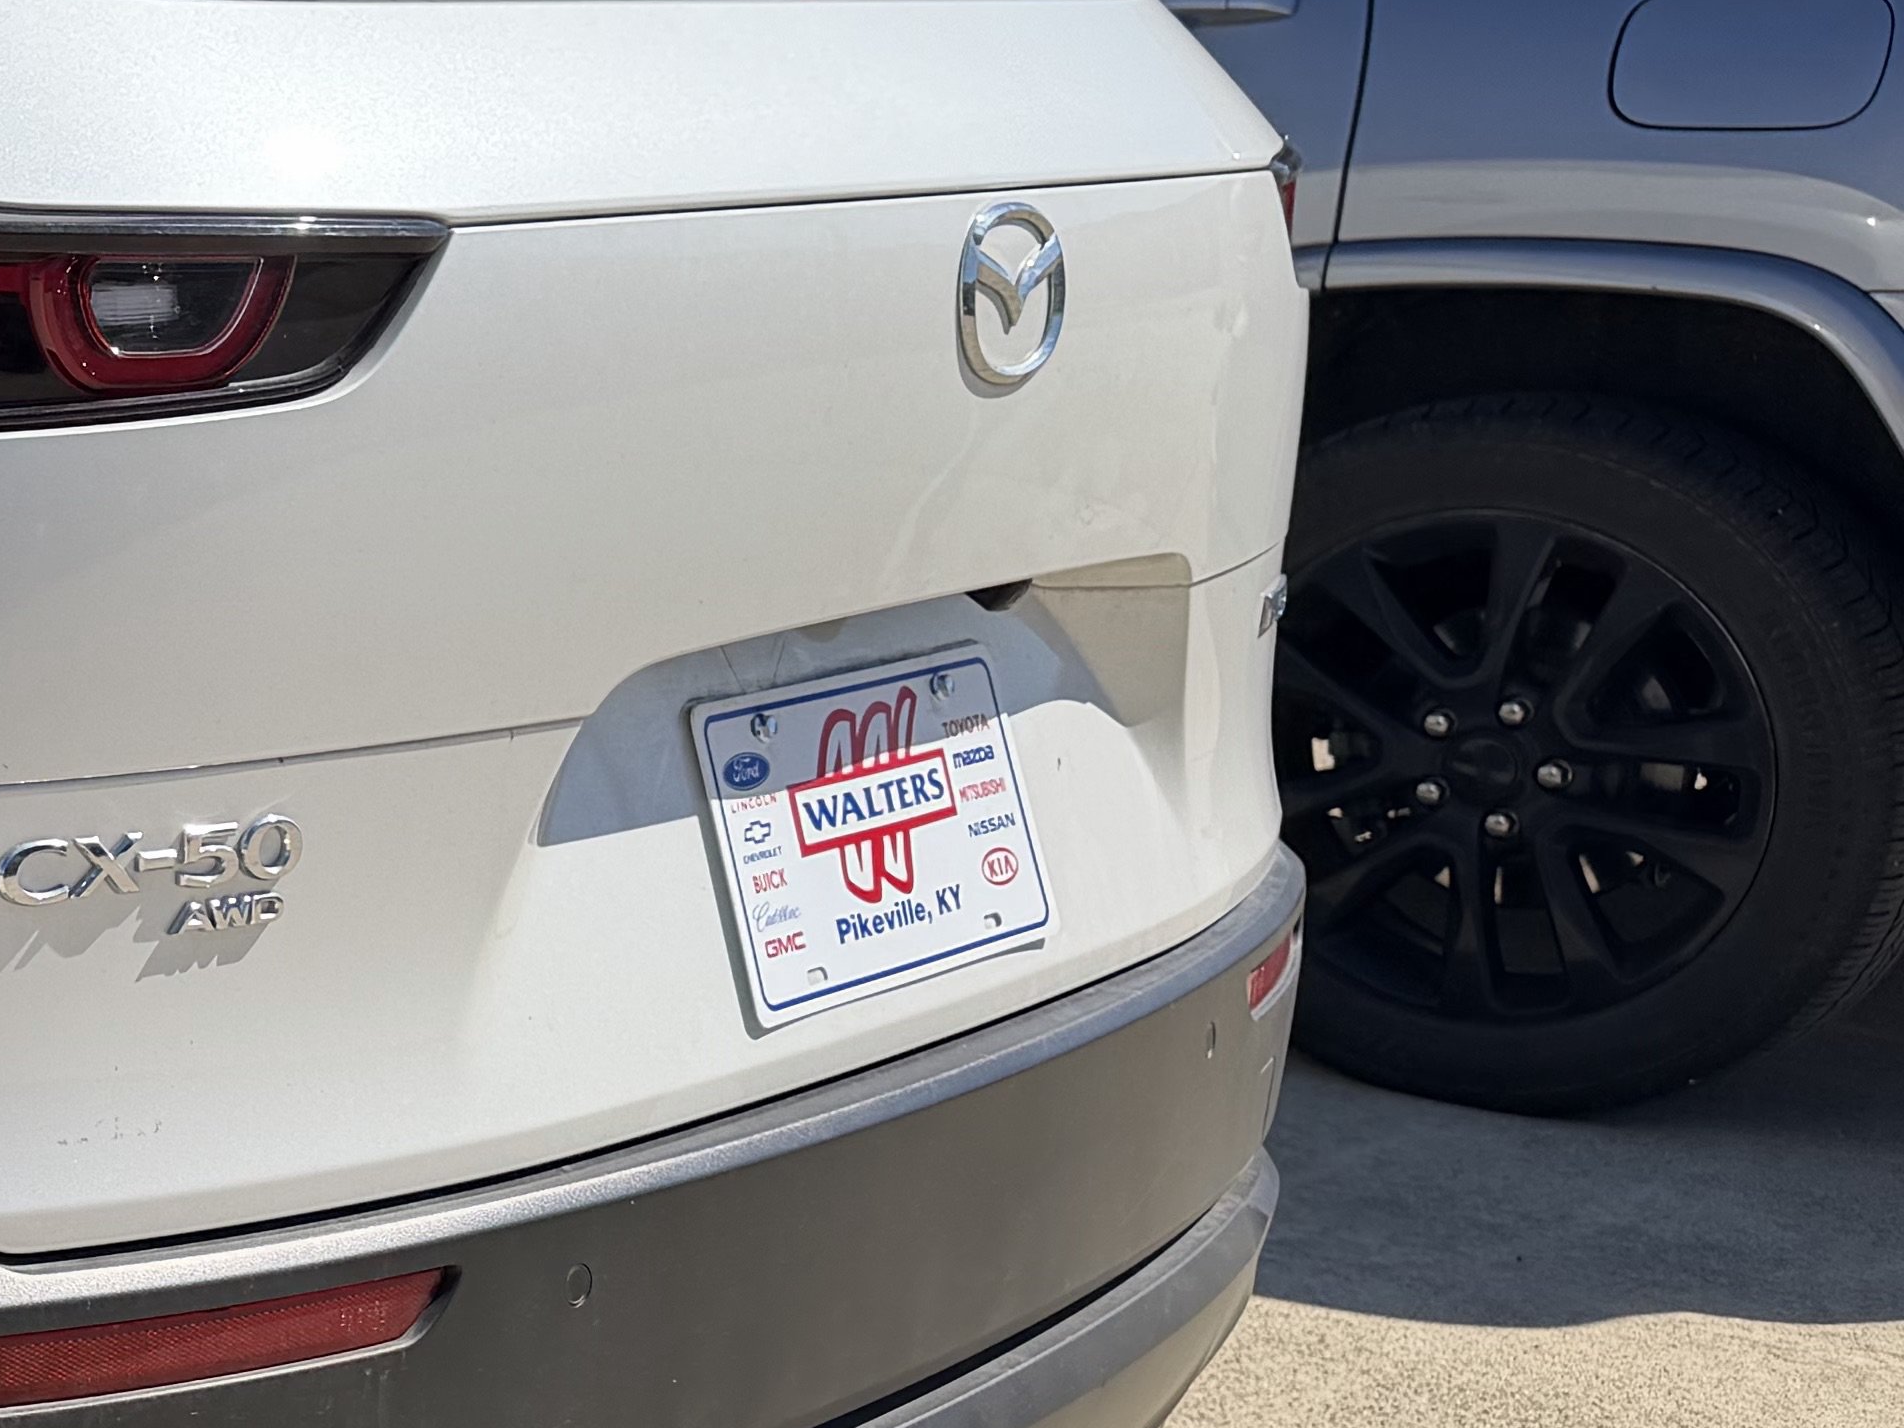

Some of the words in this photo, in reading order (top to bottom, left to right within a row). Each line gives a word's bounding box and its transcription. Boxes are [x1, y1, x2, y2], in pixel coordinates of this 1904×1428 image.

[942, 713, 990, 738] TOYOTA
[953, 745, 995, 769] mazda
[802, 768, 945, 832] WALTERS
[959, 777, 1007, 803] MITSUBISHI
[731, 793, 777, 813] LINCOLN
[968, 813, 1016, 838] NISSAN
[743, 846, 782, 864] CHEVROLET
[987, 855, 1015, 878] KIA
[752, 868, 788, 893] BUICK
[167, 890, 285, 936] AWD
[836, 899, 933, 944] Pikeville,
[935, 884, 962, 915] KY
[765, 931, 806, 958] GMC
